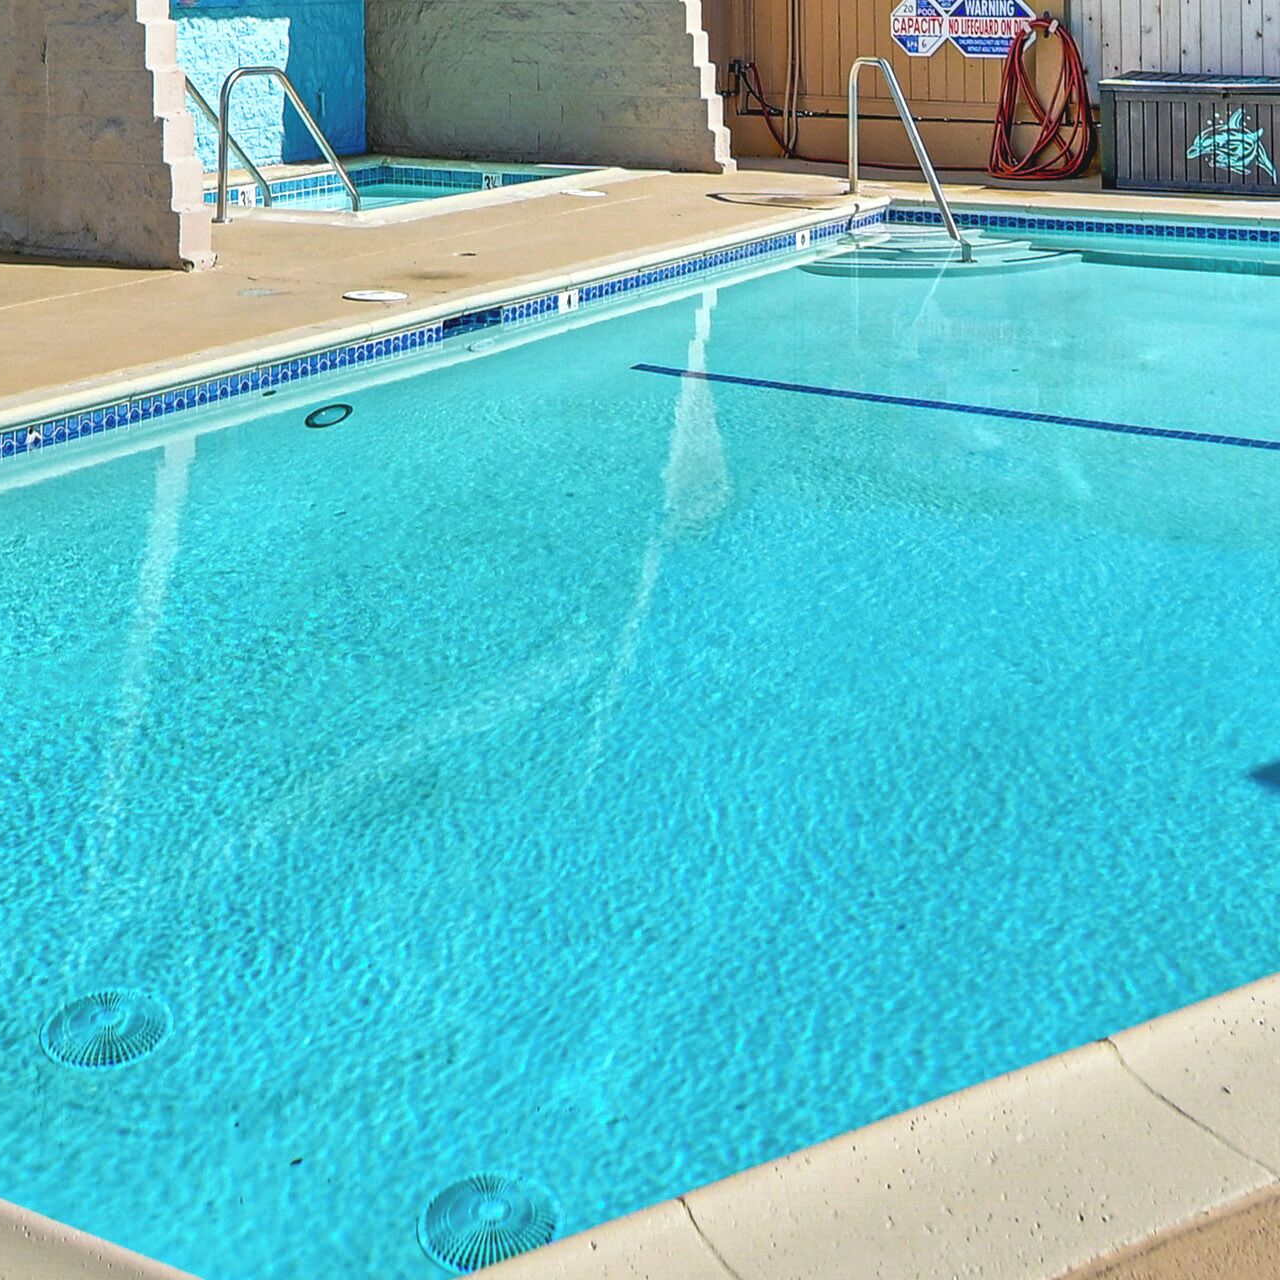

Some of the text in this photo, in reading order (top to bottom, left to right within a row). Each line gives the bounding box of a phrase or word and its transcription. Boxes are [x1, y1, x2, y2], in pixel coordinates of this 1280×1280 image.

[903, 4, 914, 13] 20
[917, 8, 937, 16] POOL
[964, 0, 1015, 17] WARNING
[892, 18, 944, 34] CAPACITY
[949, 19, 959, 35] NO
[961, 19, 999, 35] LIFEGUARD
[1001, 19, 1012, 35] ON
[921, 39, 927, 48] 6
